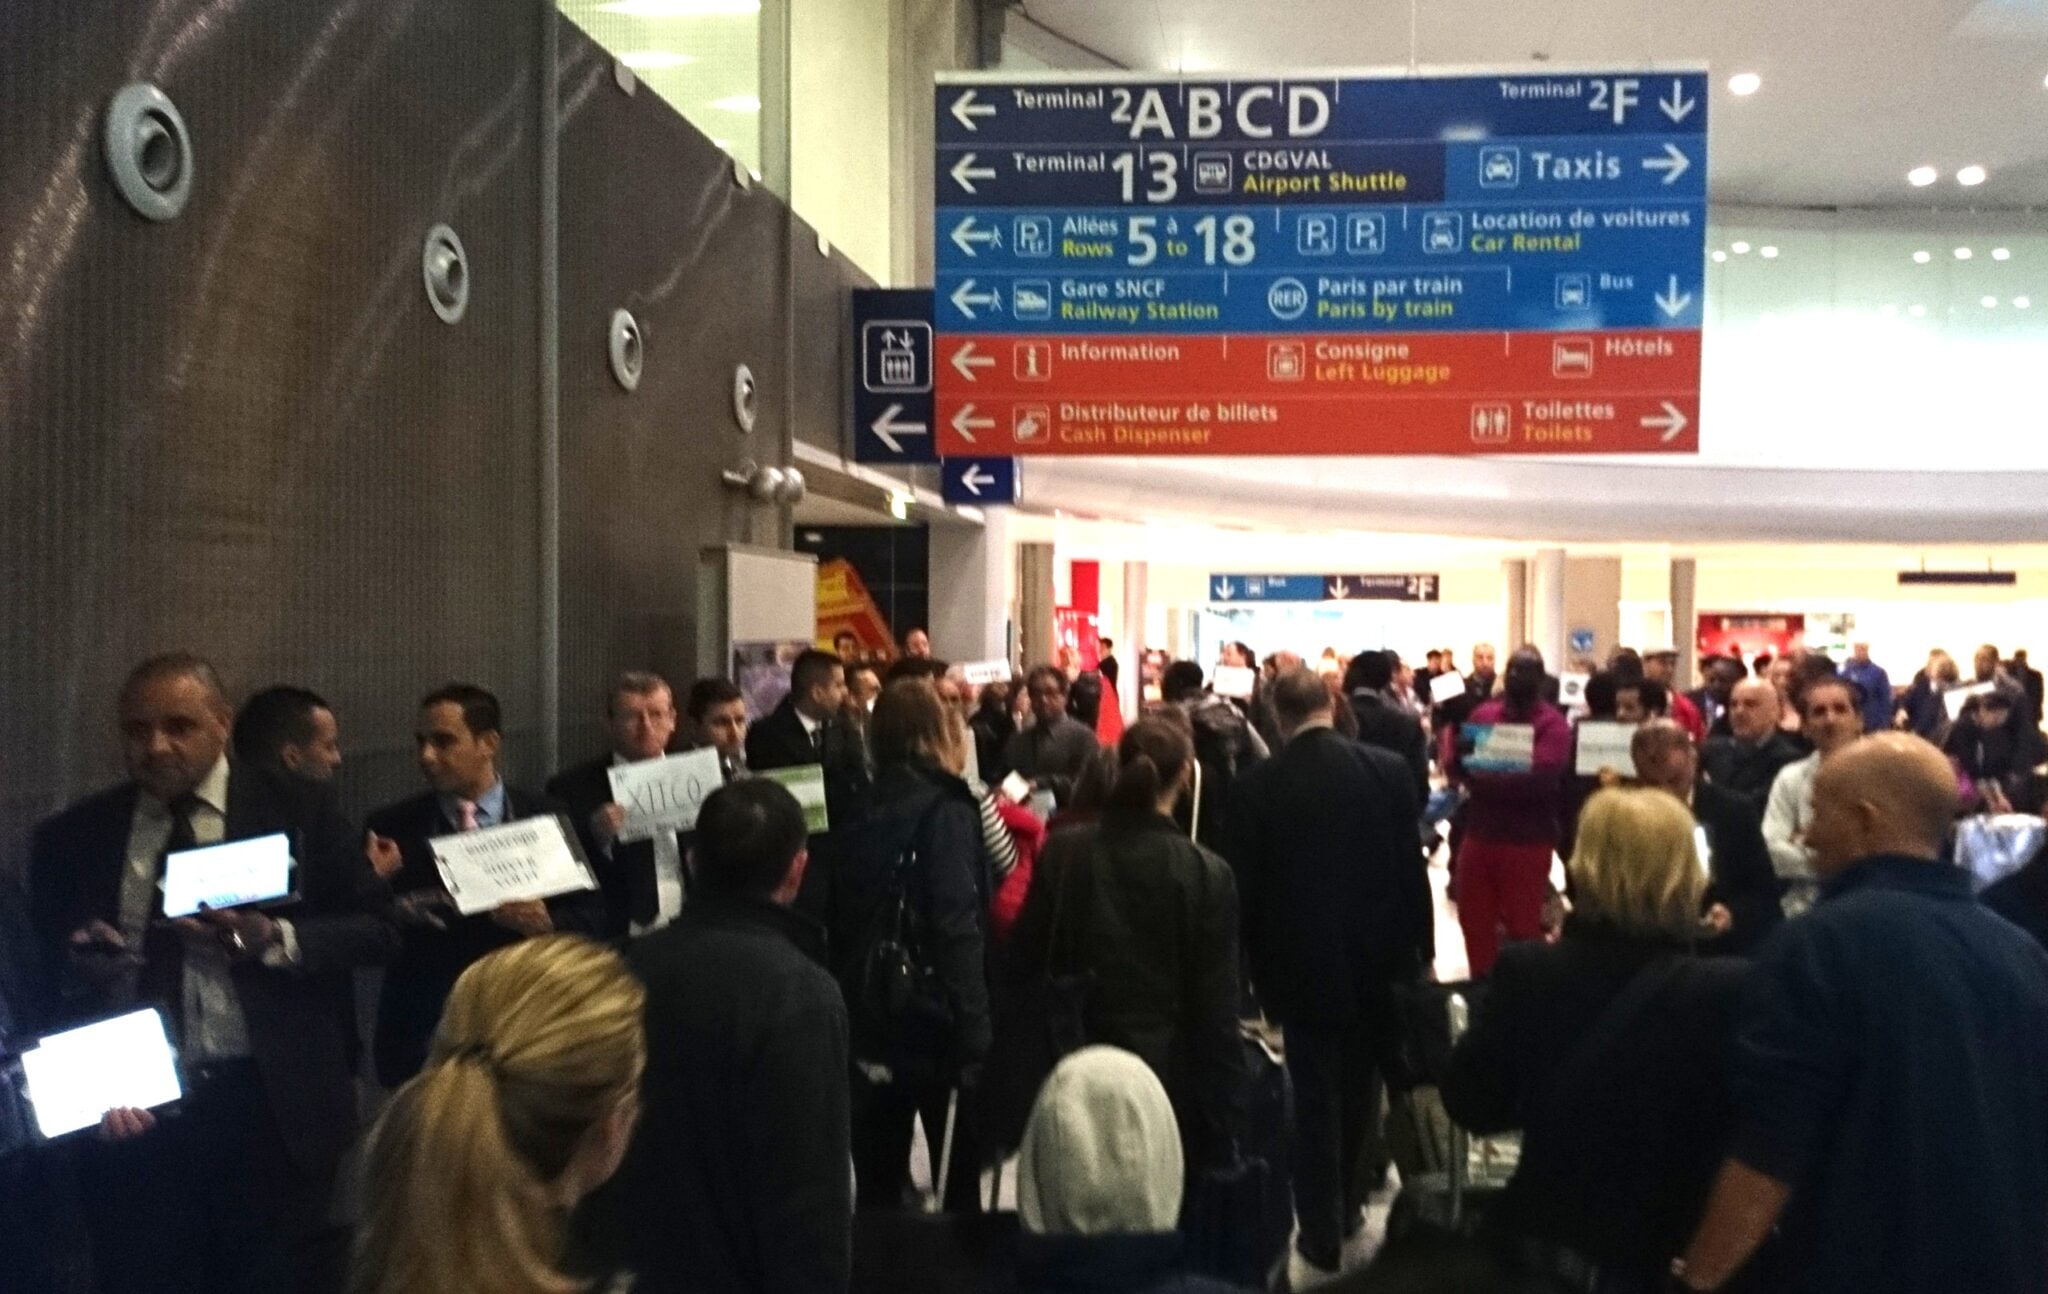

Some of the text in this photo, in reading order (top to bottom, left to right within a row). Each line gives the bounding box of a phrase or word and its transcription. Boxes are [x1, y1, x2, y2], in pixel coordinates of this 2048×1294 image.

[1013, 85, 1331, 140] Terminal 2A B C D
[1499, 79, 1640, 125] Terminal 2F
[1243, 150, 1332, 170] CDGVAL
[1531, 150, 1621, 180] Taxis
[1013, 153, 1178, 202] Terminal 1 3
[1243, 170, 1407, 196] Airport Shuttle
[1062, 215, 1119, 235] Allées
[1471, 207, 1691, 230] Location de voitures
[1062, 240, 1114, 258] Rows
[1127, 215, 1157, 266] 5
[1166, 241, 1188, 257] to
[1194, 215, 1256, 267] 18
[1470, 232, 1581, 253] Car Rental
[1061, 278, 1165, 297] Gare SNCF
[1317, 277, 1463, 304] Paris par train
[1599, 273, 1634, 291] Bus
[1061, 301, 1219, 324] Railway Station
[1316, 299, 1453, 321] Paris by train
[1061, 342, 1180, 361] Information
[1315, 340, 1409, 364] Consigne
[1605, 337, 1673, 357] Hôtels
[1315, 363, 1451, 384] Left Luggage
[1060, 403, 1278, 422] Distributeur de billets
[1523, 402, 1614, 421] Toilettes
[1060, 425, 1211, 448] Cash Dispenser
[1522, 425, 1593, 442] Toilets
[1407, 575, 1434, 600] 2F
